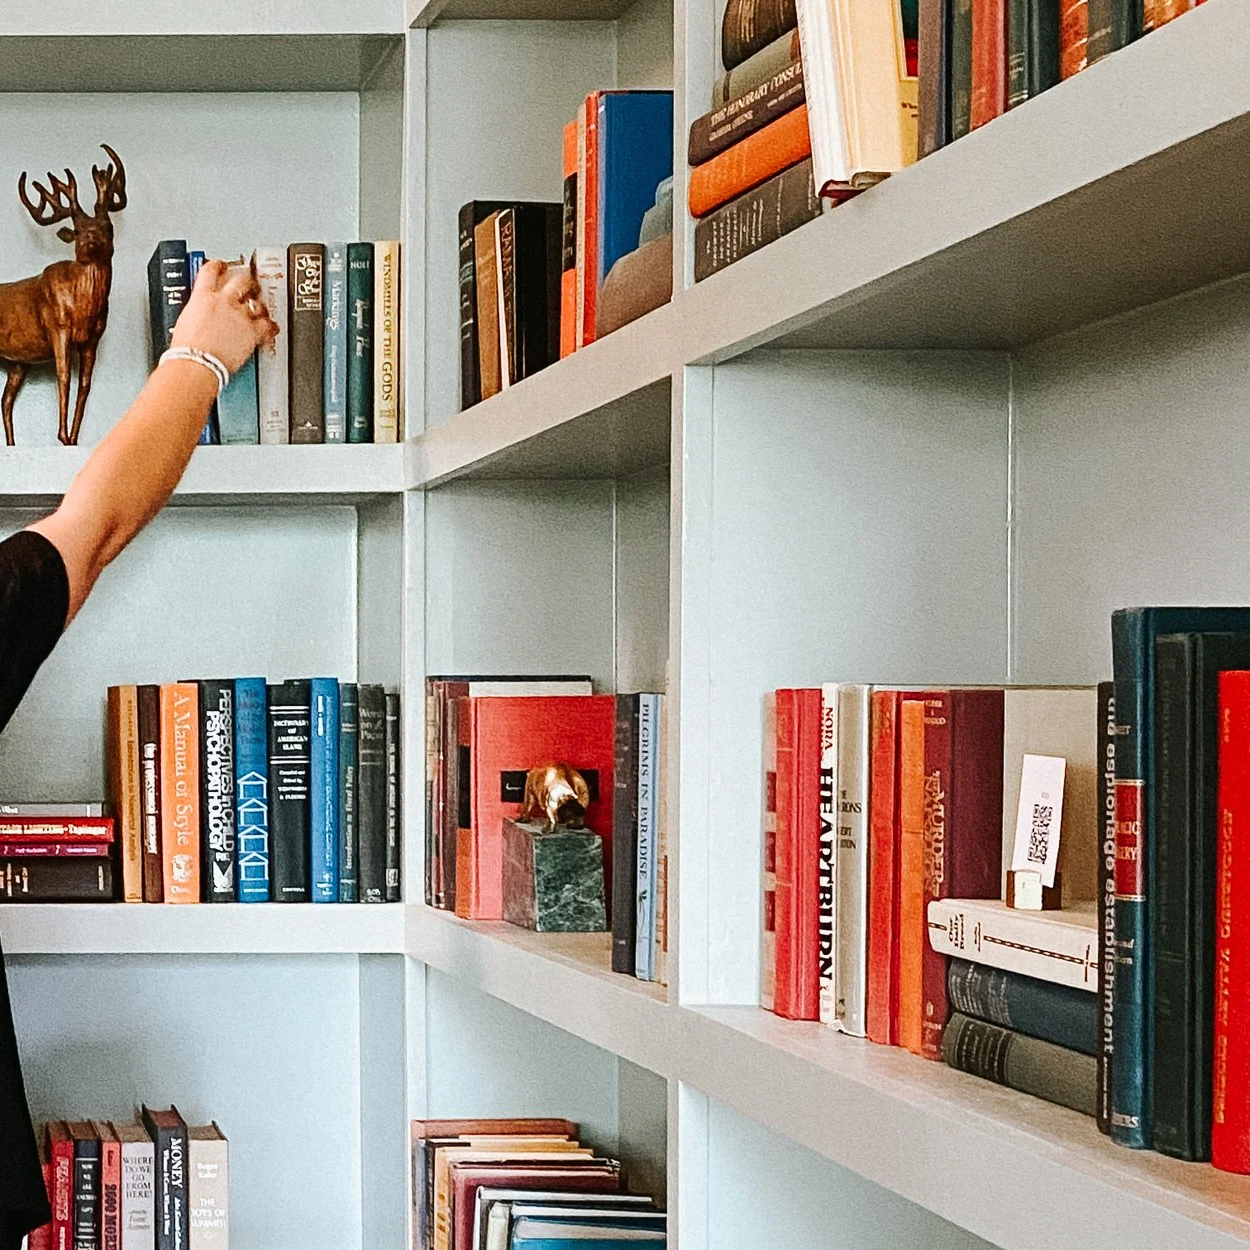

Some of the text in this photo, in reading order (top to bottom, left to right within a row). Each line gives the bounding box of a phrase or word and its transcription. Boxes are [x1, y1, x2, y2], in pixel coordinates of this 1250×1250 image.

[327, 279, 342, 330] Markings
[383, 254, 392, 317] WINDMILLS
[383, 319, 392, 334] OF
[383, 338, 392, 359] THE
[381, 361, 393, 401] GODS
[144, 743, 157, 758] the
[277, 735, 308, 743] AMERICAN
[824, 706, 834, 751] NORA
[174, 691, 193, 847] A Manual of Style
[206, 710, 224, 851] PSYCHOPATHOLOGY
[219, 689, 235, 851] PERSPECTIVES in CHILD
[639, 704, 650, 879] PILGRIMS IN PARADISE
[932, 791, 944, 884] MURDER
[819, 767, 834, 981] HEARTBURN
[1103, 743, 1117, 1053] espionage establishment
[123, 1157, 153, 1165] WHERE
[126, 1182, 151, 1190] FROM
[170, 1138, 182, 1188] MONEY
[56, 1156, 68, 1221] PEANUTS
[200, 1198, 216, 1207] THE
